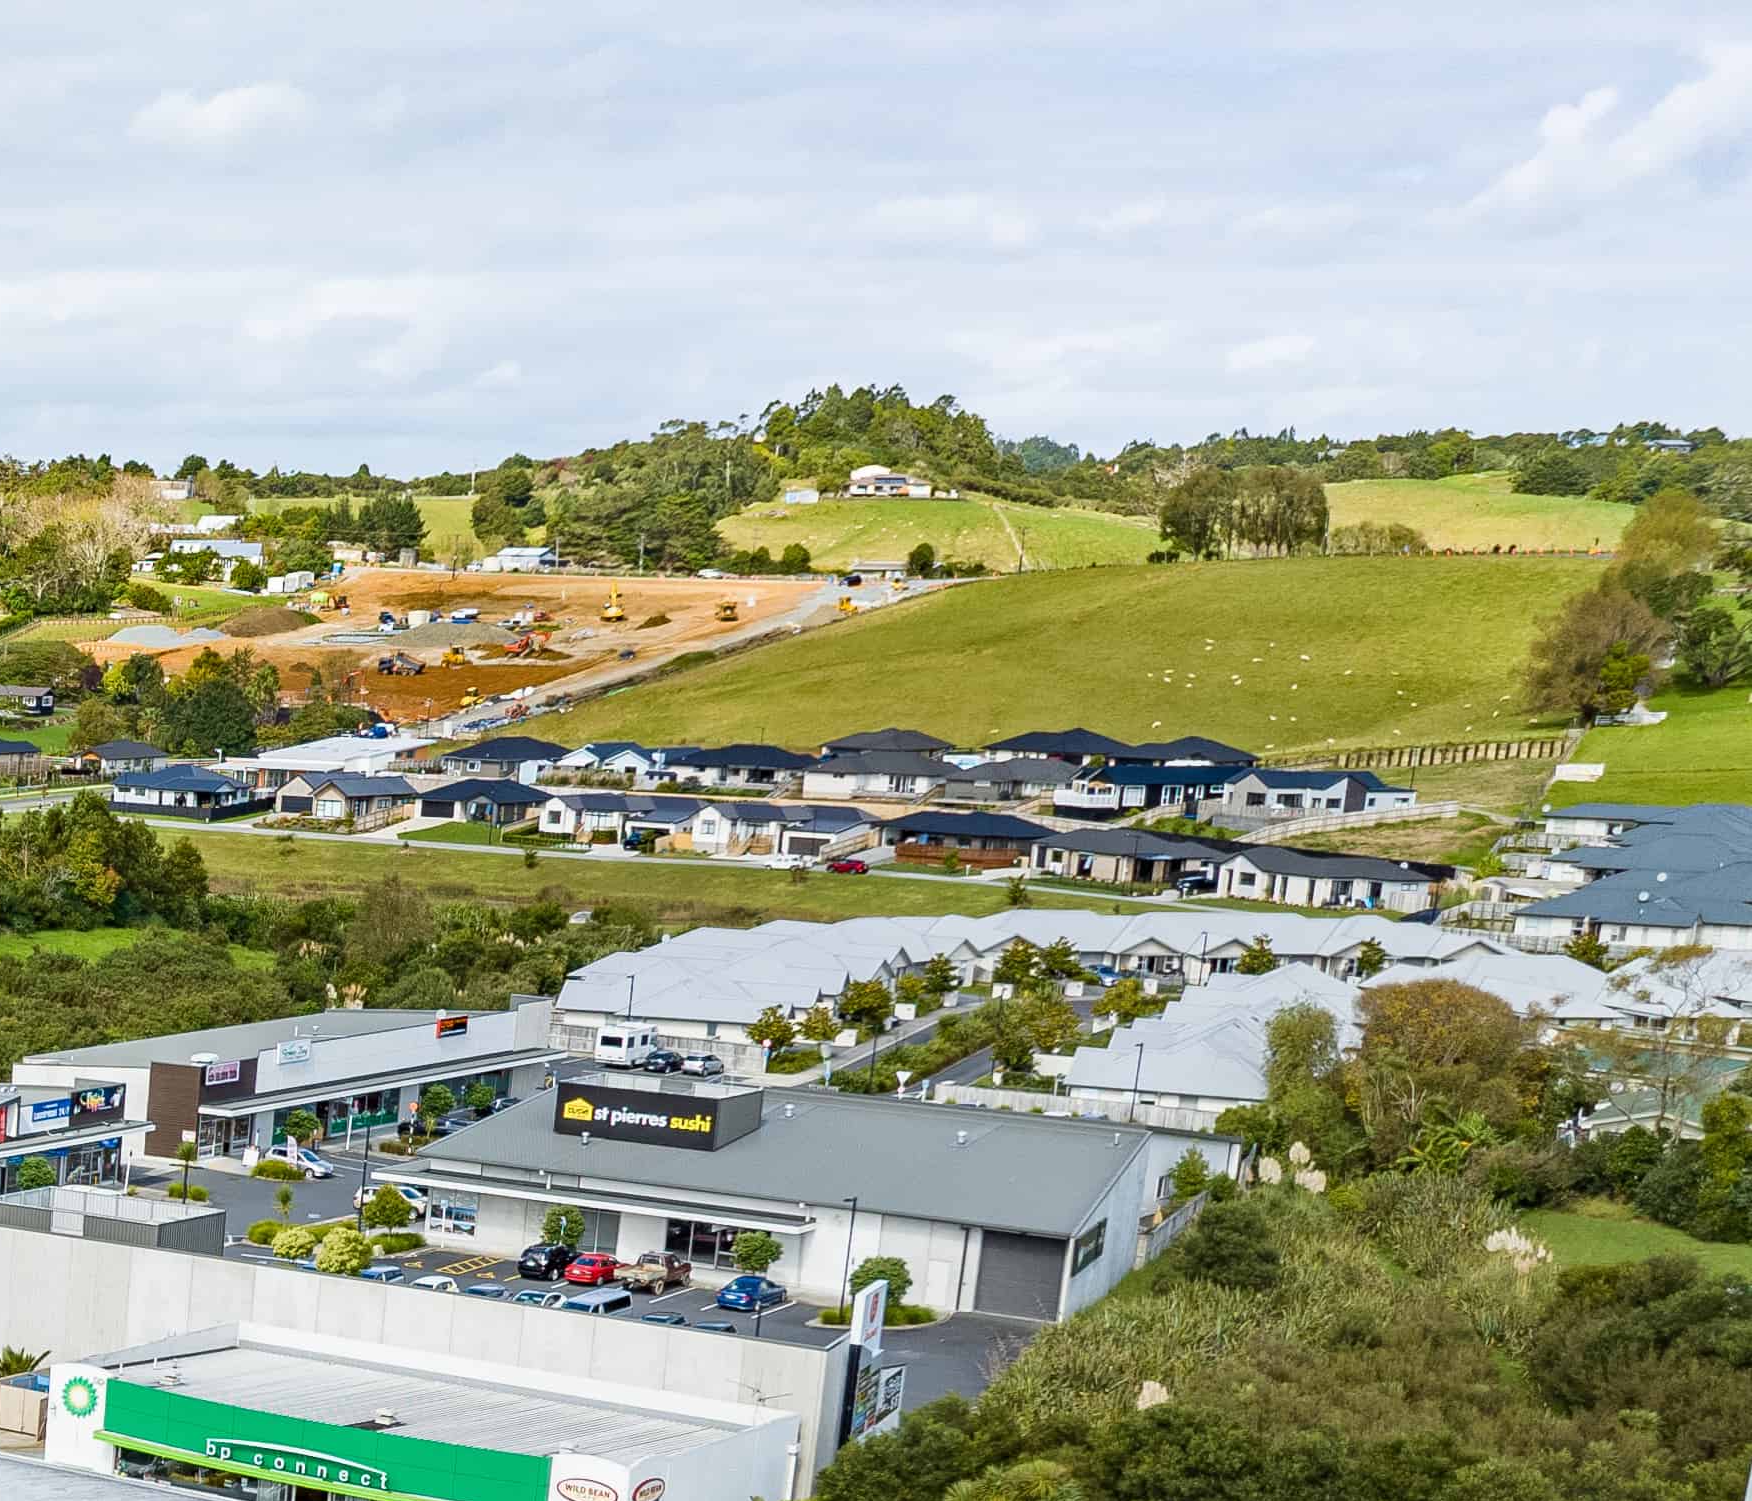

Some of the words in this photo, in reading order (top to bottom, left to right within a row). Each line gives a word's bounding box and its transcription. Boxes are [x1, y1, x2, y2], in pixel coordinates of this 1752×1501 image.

[593, 1106, 609, 1121] st
[610, 1107, 668, 1127] pierres
[670, 1114, 712, 1132] sushi
[206, 1440, 231, 1461] bp
[253, 1453, 388, 1490] connect
[565, 1483, 586, 1494] WILD
[589, 1487, 611, 1499] BEAN
